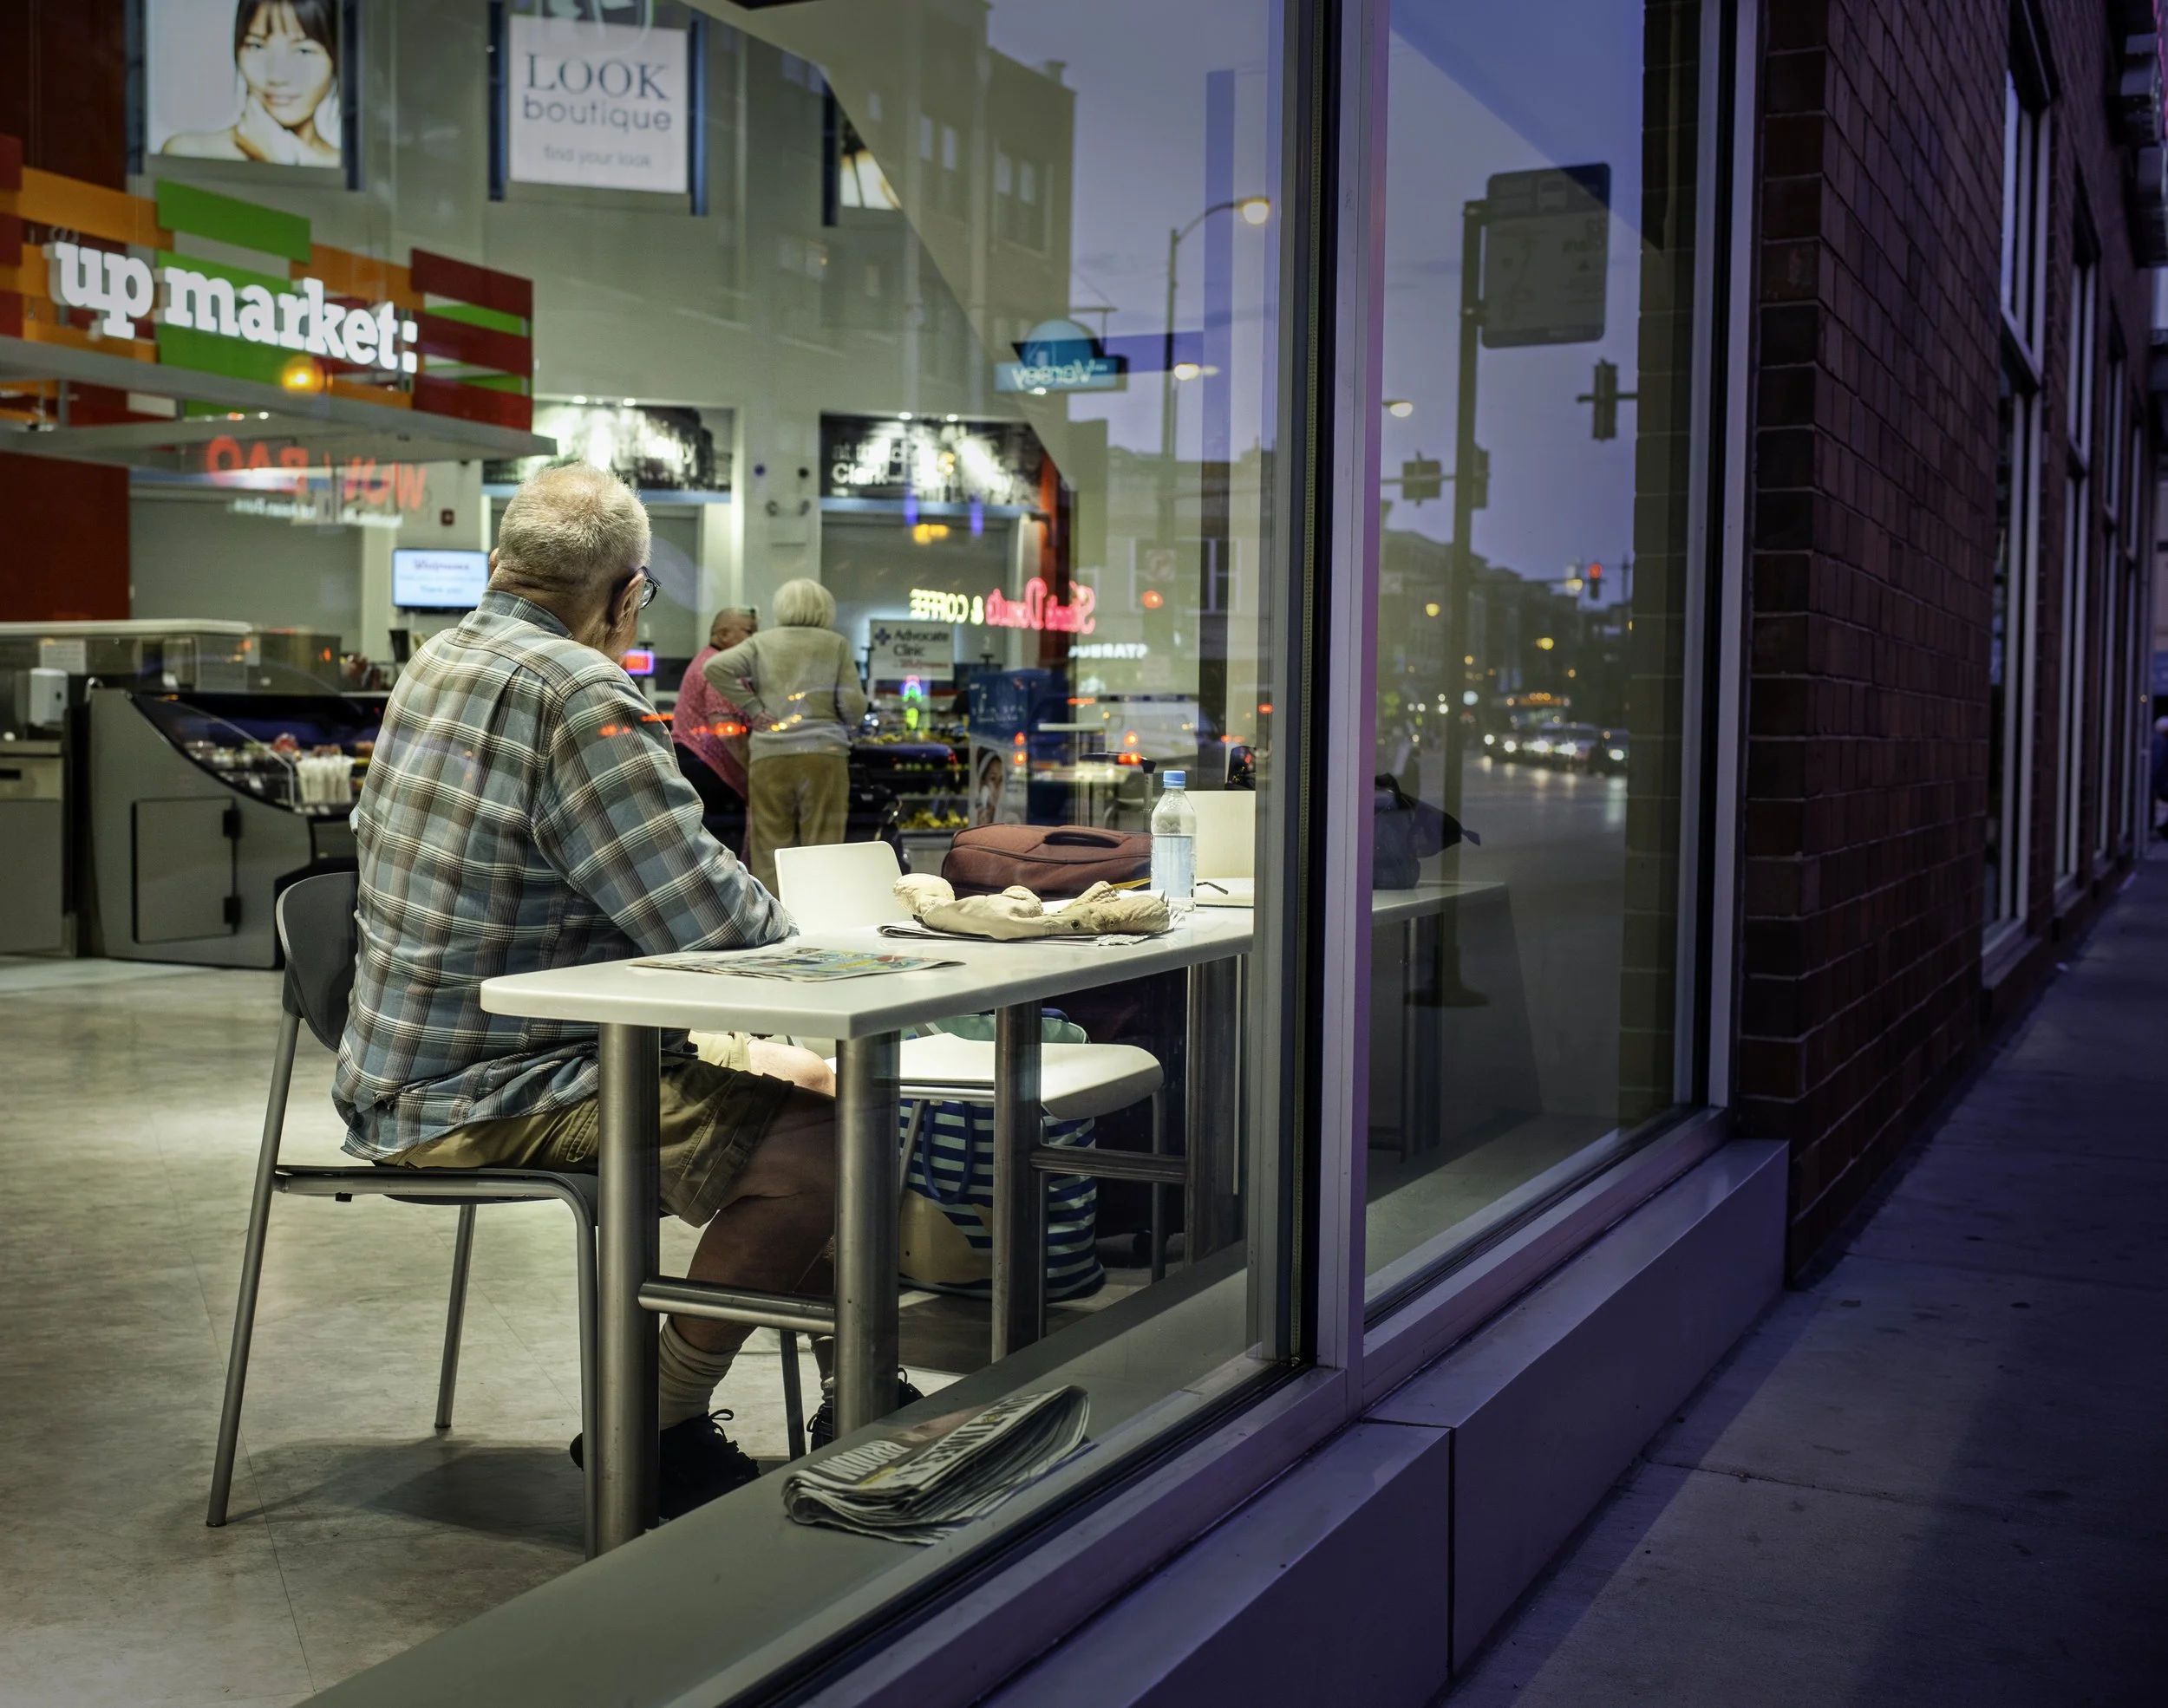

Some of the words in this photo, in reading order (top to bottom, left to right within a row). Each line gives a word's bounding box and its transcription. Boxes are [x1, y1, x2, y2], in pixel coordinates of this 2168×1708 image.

[526, 51, 669, 101] LOOK
[523, 95, 672, 133] boutique
[544, 146, 574, 163] find
[578, 150, 614, 168] your
[617, 150, 651, 168] look
[52, 241, 155, 339] up
[893, 643, 925, 657] Clinic
[894, 628, 950, 642] Advocate
